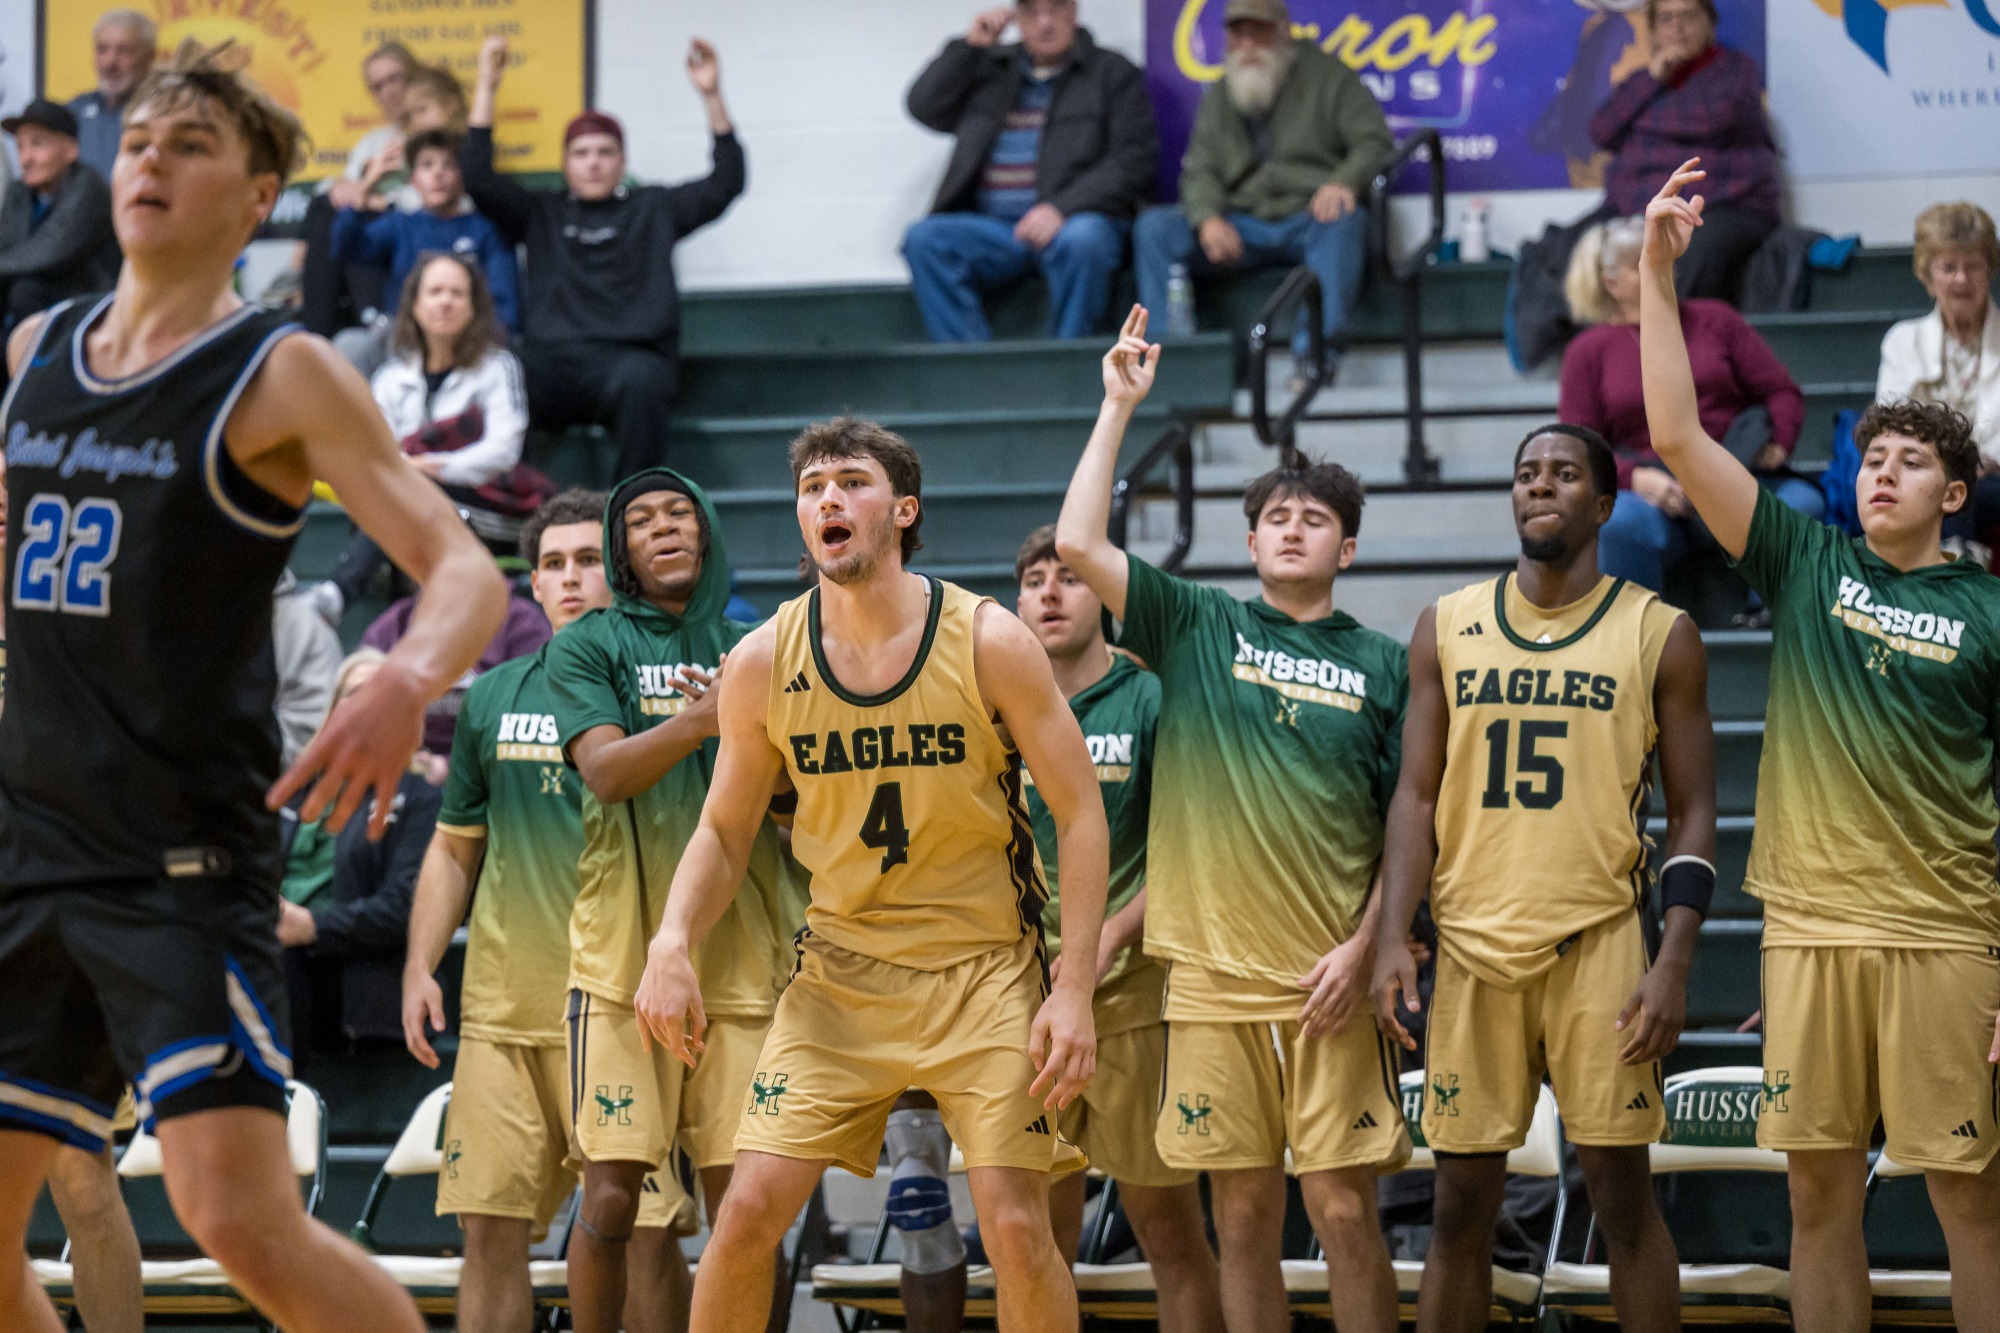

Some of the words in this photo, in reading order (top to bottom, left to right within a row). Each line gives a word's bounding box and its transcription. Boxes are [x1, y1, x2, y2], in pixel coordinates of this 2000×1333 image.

[12, 492, 123, 618] 22
[1838, 575, 1966, 649] HUSSON
[1455, 668, 1617, 711] EAGLES
[497, 713, 559, 744] HUS
[789, 723, 966, 775] EAGLES
[1481, 718, 1569, 810] 15
[858, 781, 910, 875] 4
[1673, 1090, 1761, 1123] HUSSO
